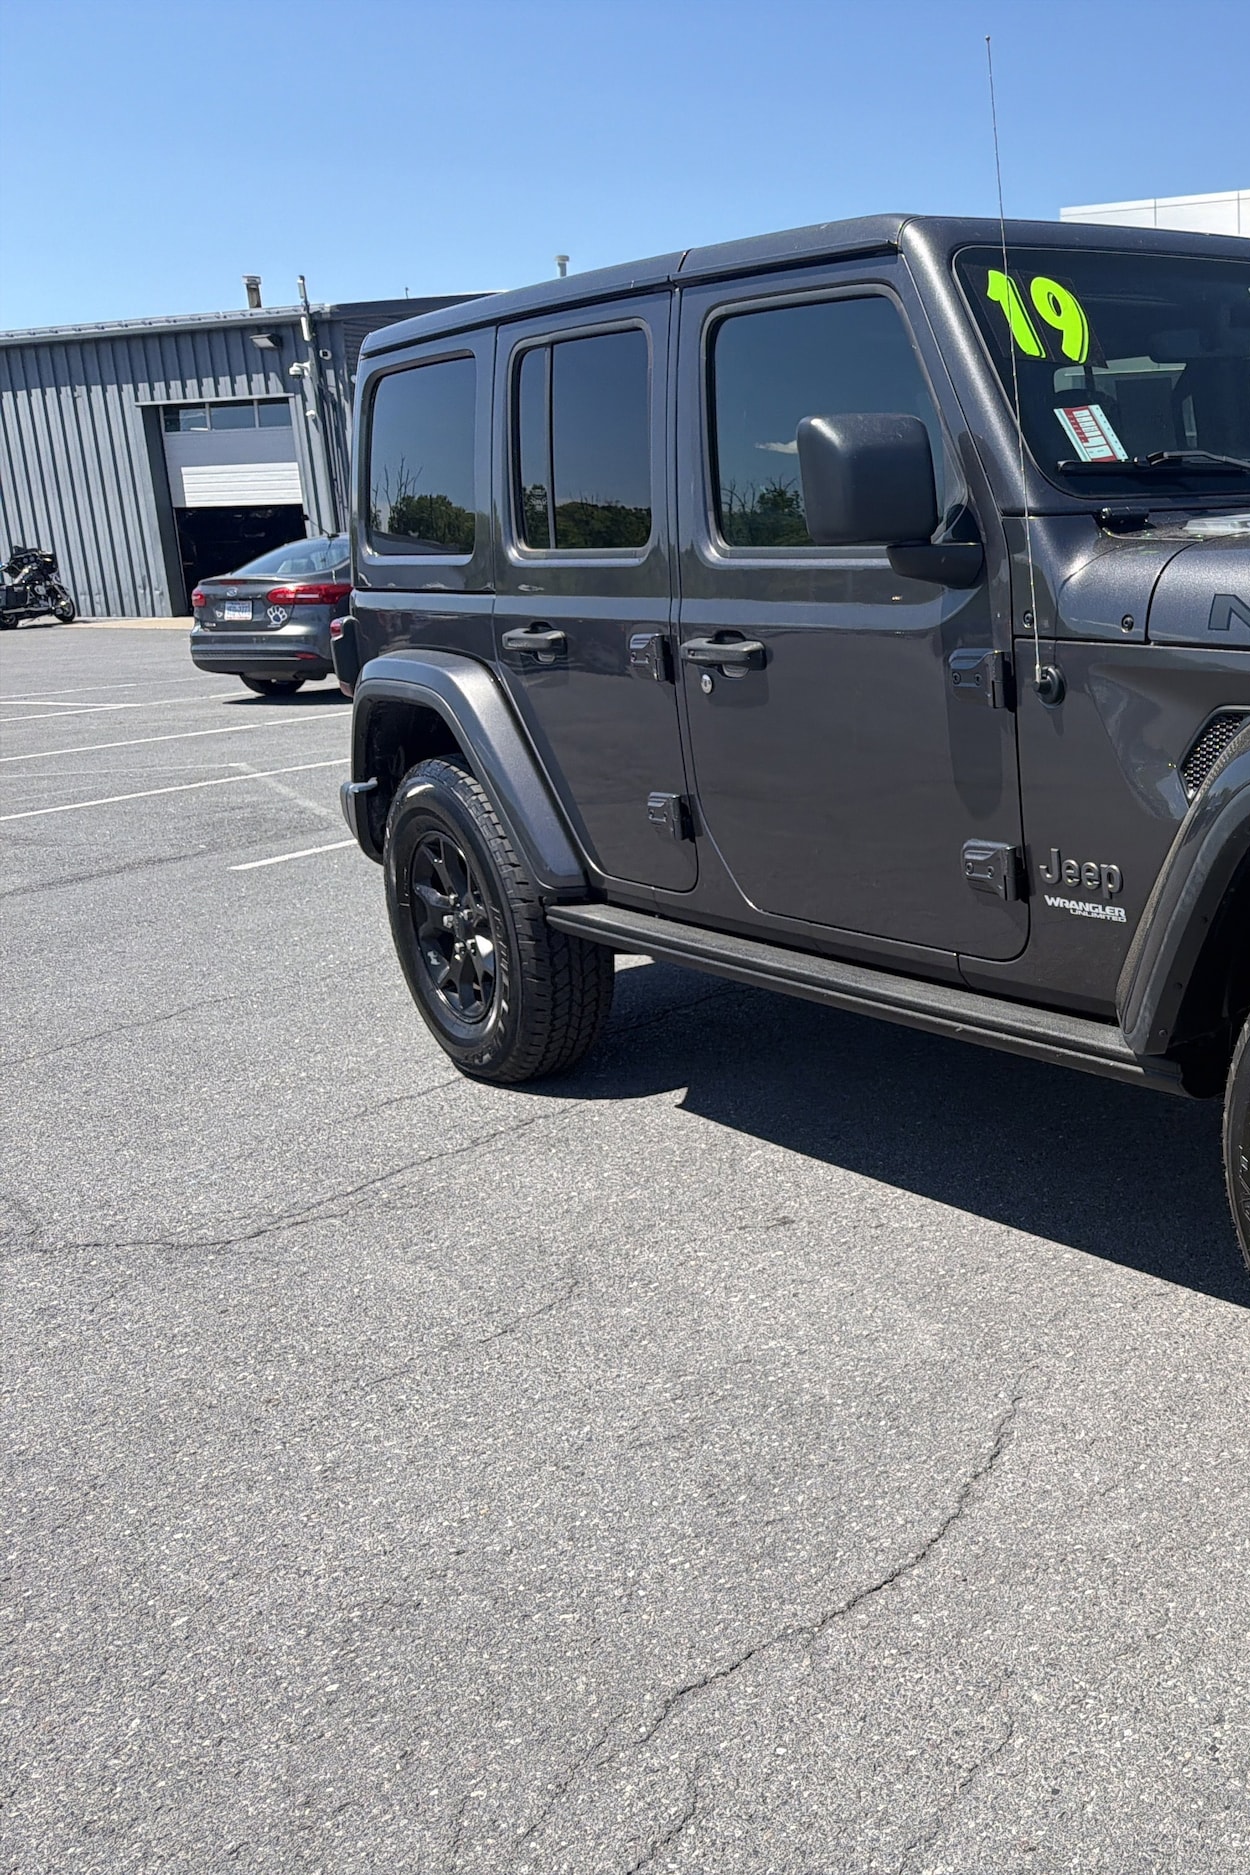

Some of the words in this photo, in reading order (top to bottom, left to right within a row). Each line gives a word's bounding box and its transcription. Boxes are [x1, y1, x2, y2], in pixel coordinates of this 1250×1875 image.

[986, 269, 1090, 364] 19
[1039, 847, 1123, 899] Jeep
[1044, 894, 1126, 918] WRANGLER
[1069, 908, 1127, 923] UNLIMITED
